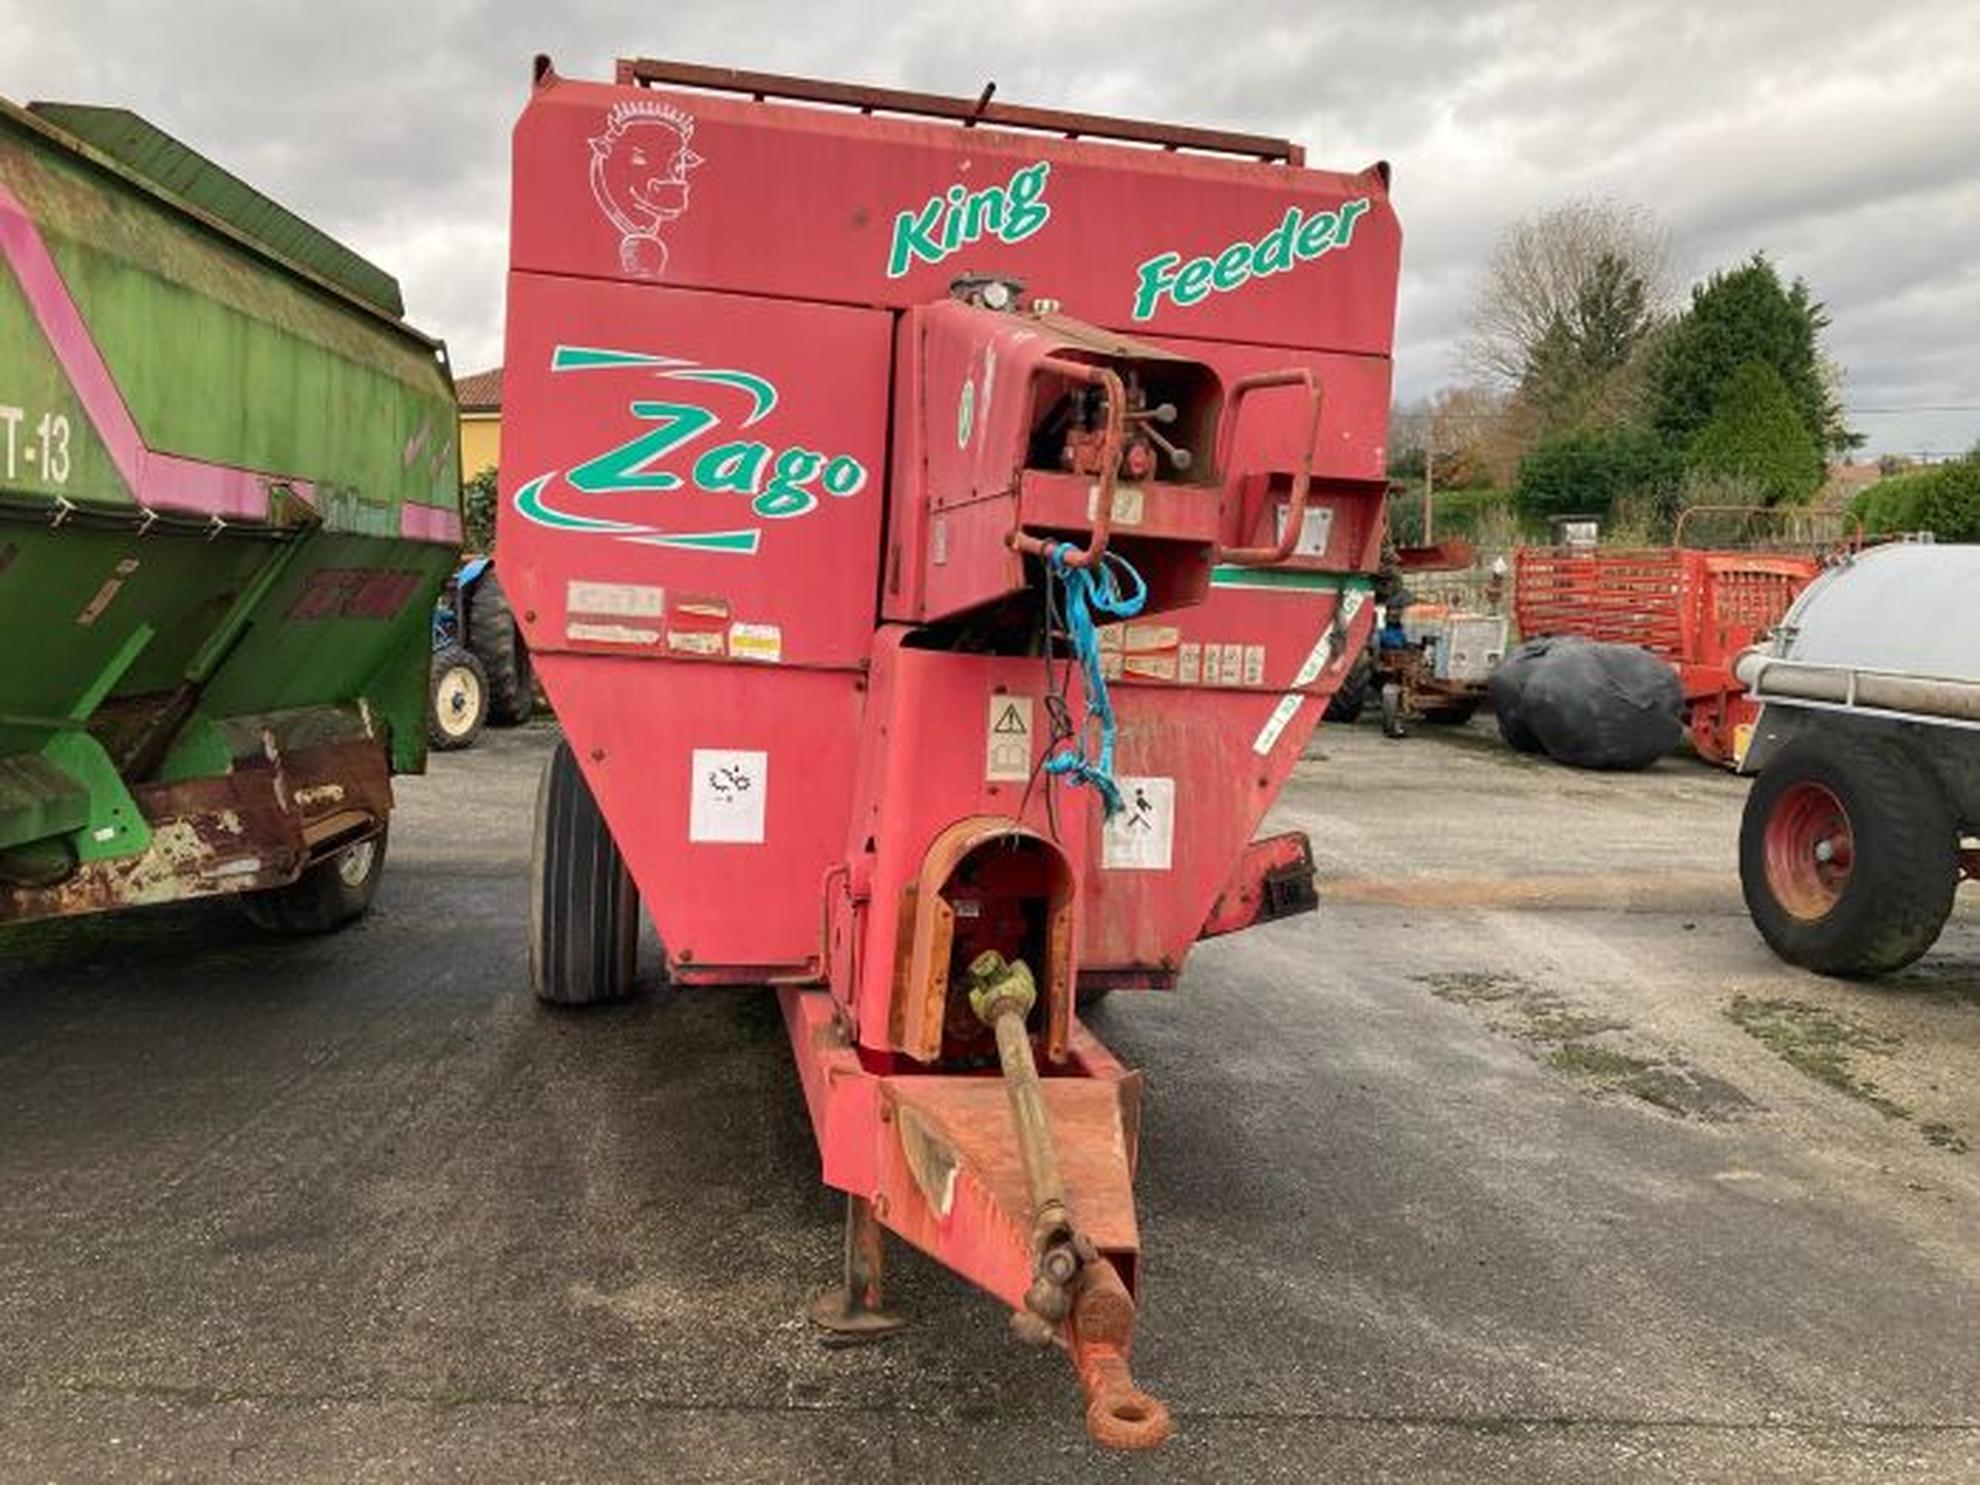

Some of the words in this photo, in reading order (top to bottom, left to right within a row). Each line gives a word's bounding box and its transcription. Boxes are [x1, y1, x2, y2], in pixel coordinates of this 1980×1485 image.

[887, 160, 1051, 278] King
[1131, 198, 1371, 321] Feeder
[565, 401, 868, 518] Zago
